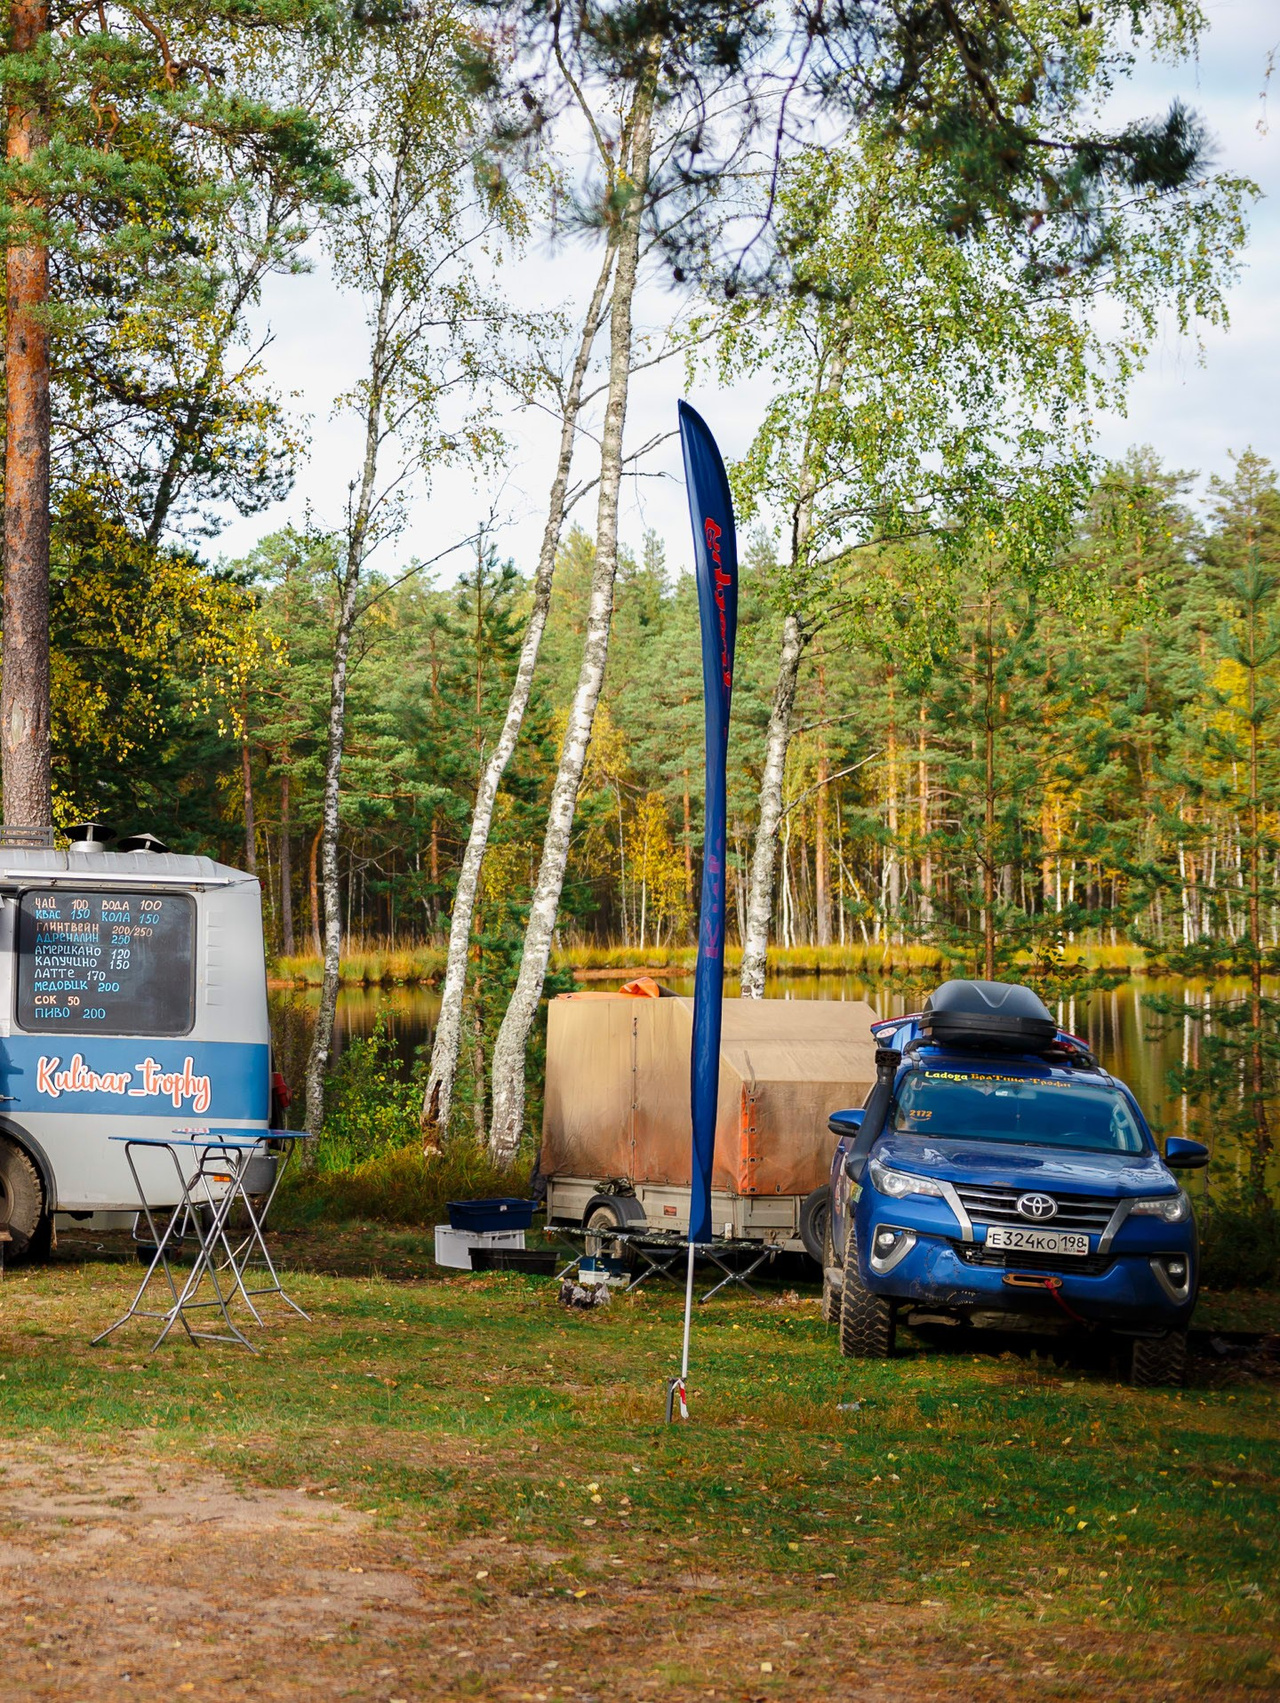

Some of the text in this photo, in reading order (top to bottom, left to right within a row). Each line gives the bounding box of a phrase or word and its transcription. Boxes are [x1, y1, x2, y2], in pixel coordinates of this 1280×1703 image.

[35, 897, 162, 911] ЧАЙ 100 ВОДА 100
[35, 909, 160, 924] КВАС 150 КОЛА 150
[36, 922, 153, 937] ГЛИНТВЕЙН 200/250
[36, 932, 130, 944] АДРЕНАЛИН 250
[35, 944, 130, 960] АМЕРИКАНО 120
[35, 956, 130, 970] КАПУЧИНО 150
[34, 968, 106, 981] ЛАТТЕ 170
[34, 980, 119, 992] МЕДОВИК 200
[35, 995, 80, 1006] СОК 50
[35, 1007, 106, 1019] ПИВО 200
[37, 1053, 211, 1113] Kulinar_trophy
[925, 1071, 968, 1082] Ladoga
[909, 1109, 933, 1118] 2172
